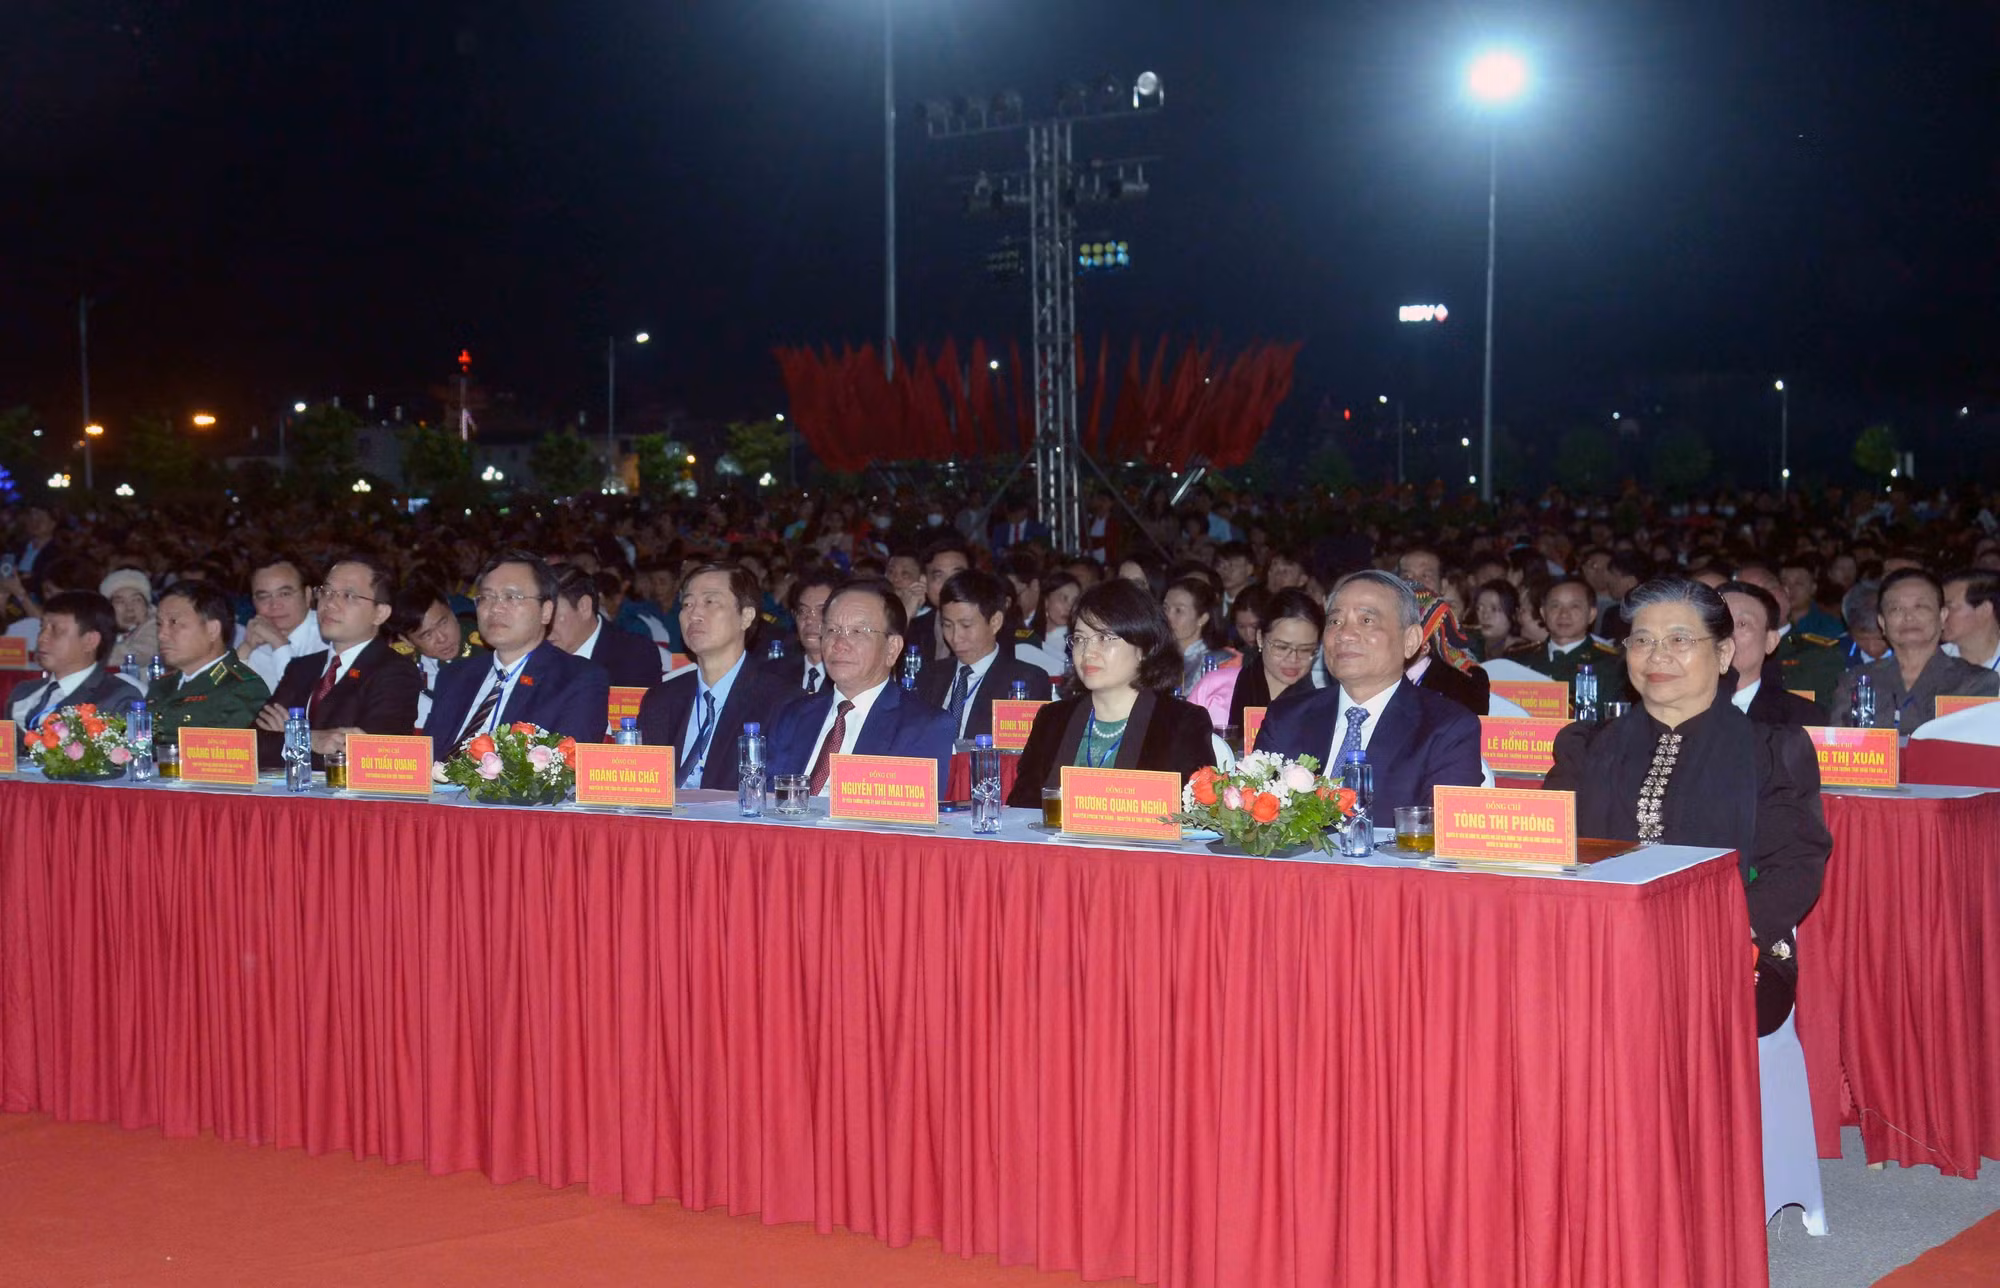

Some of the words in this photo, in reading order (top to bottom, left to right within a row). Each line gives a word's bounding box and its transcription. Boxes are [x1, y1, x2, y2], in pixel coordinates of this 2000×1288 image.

[1487, 736, 1499, 751] LÊ
[1501, 736, 1529, 752] HỒNG
[374, 754, 393, 770] TUẤN
[394, 758, 417, 771] QUANG
[1832, 751, 1849, 766] THỊ
[1853, 750, 1885, 765] XUÂN
[589, 768, 618, 783] HOÀNG
[619, 768, 637, 783] VĂN
[638, 768, 660, 784] CHẤT
[841, 778, 873, 796] NGUYỄN
[874, 783, 887, 800] THỊ
[888, 784, 904, 798] MAI
[905, 785, 925, 800] THOA
[1074, 795, 1108, 811] TRƯƠNG
[1110, 798, 1139, 814] QUANG
[1141, 798, 1169, 815] NGHĨA
[1486, 801, 1506, 810] ĐỒNG
[1507, 803, 1521, 811] CHÍ
[1488, 814, 1509, 833] THỊ
[1512, 813, 1555, 833] PHÓNG
